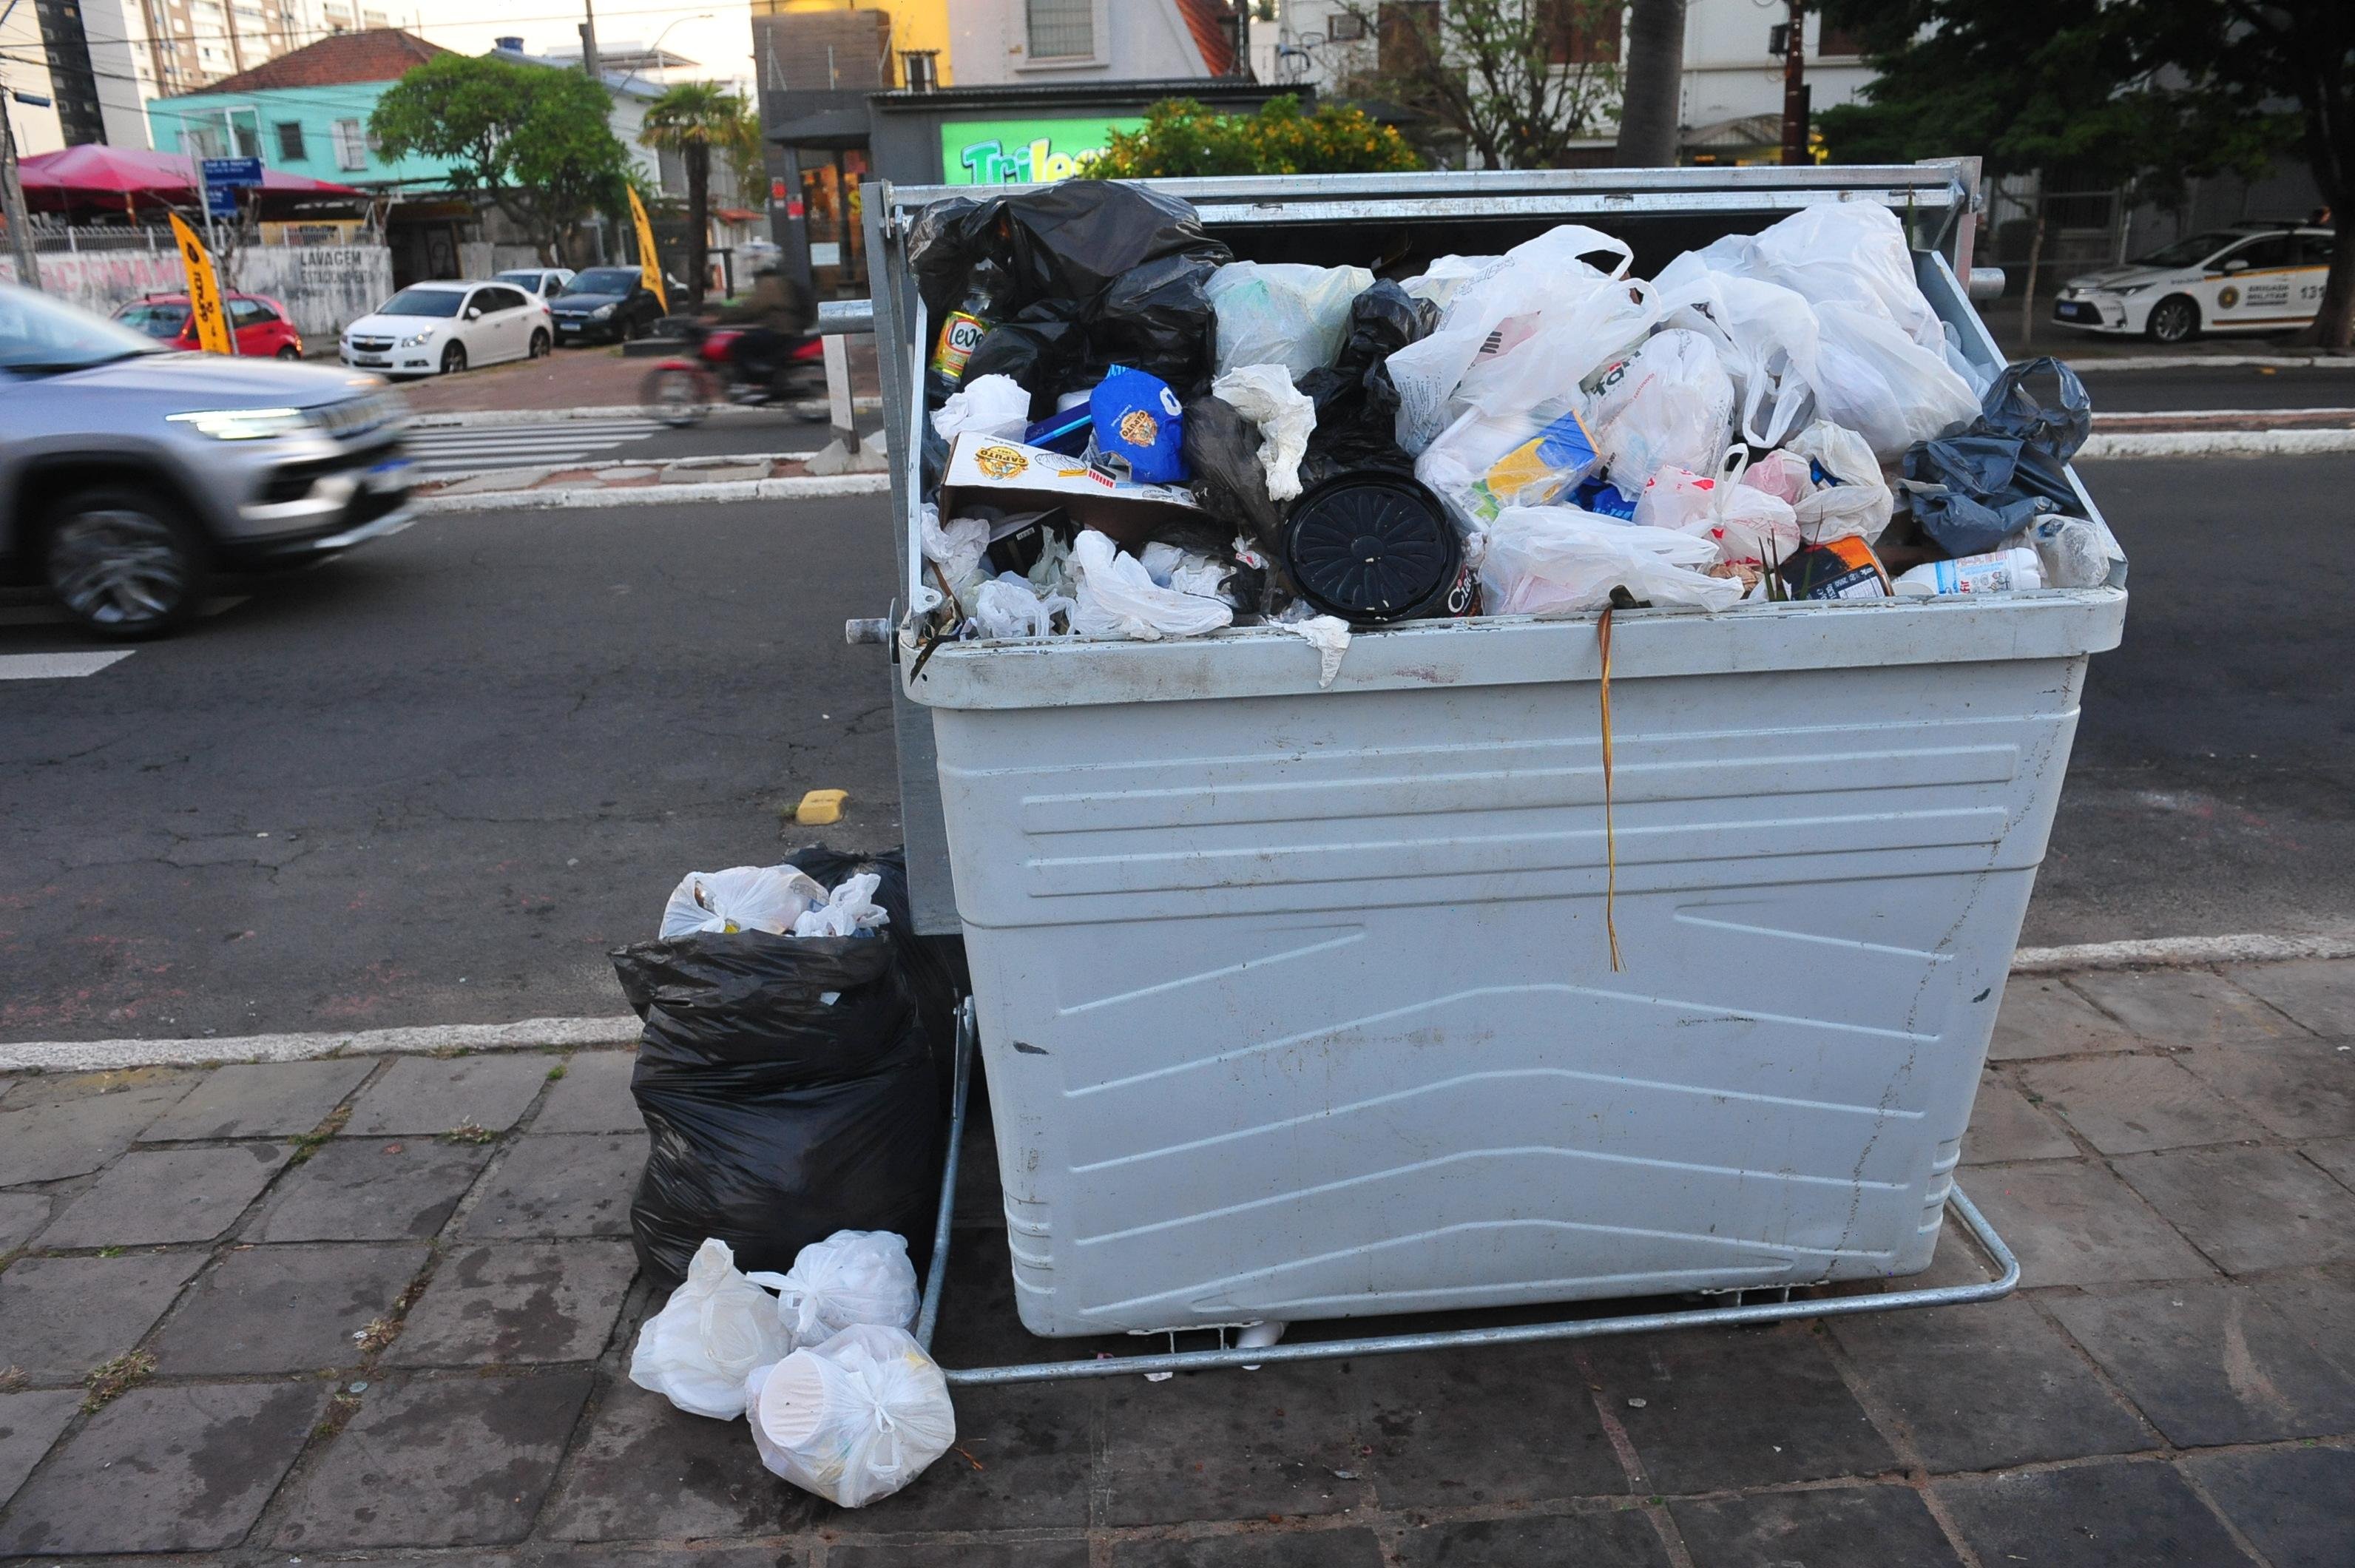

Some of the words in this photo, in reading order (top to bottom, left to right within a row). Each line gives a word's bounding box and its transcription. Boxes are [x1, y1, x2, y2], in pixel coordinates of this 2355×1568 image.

[300, 250, 362, 266] LAVAGEM
[1121, 411, 1146, 437] CAPUTO
[980, 450, 1027, 464] CAPUTO
